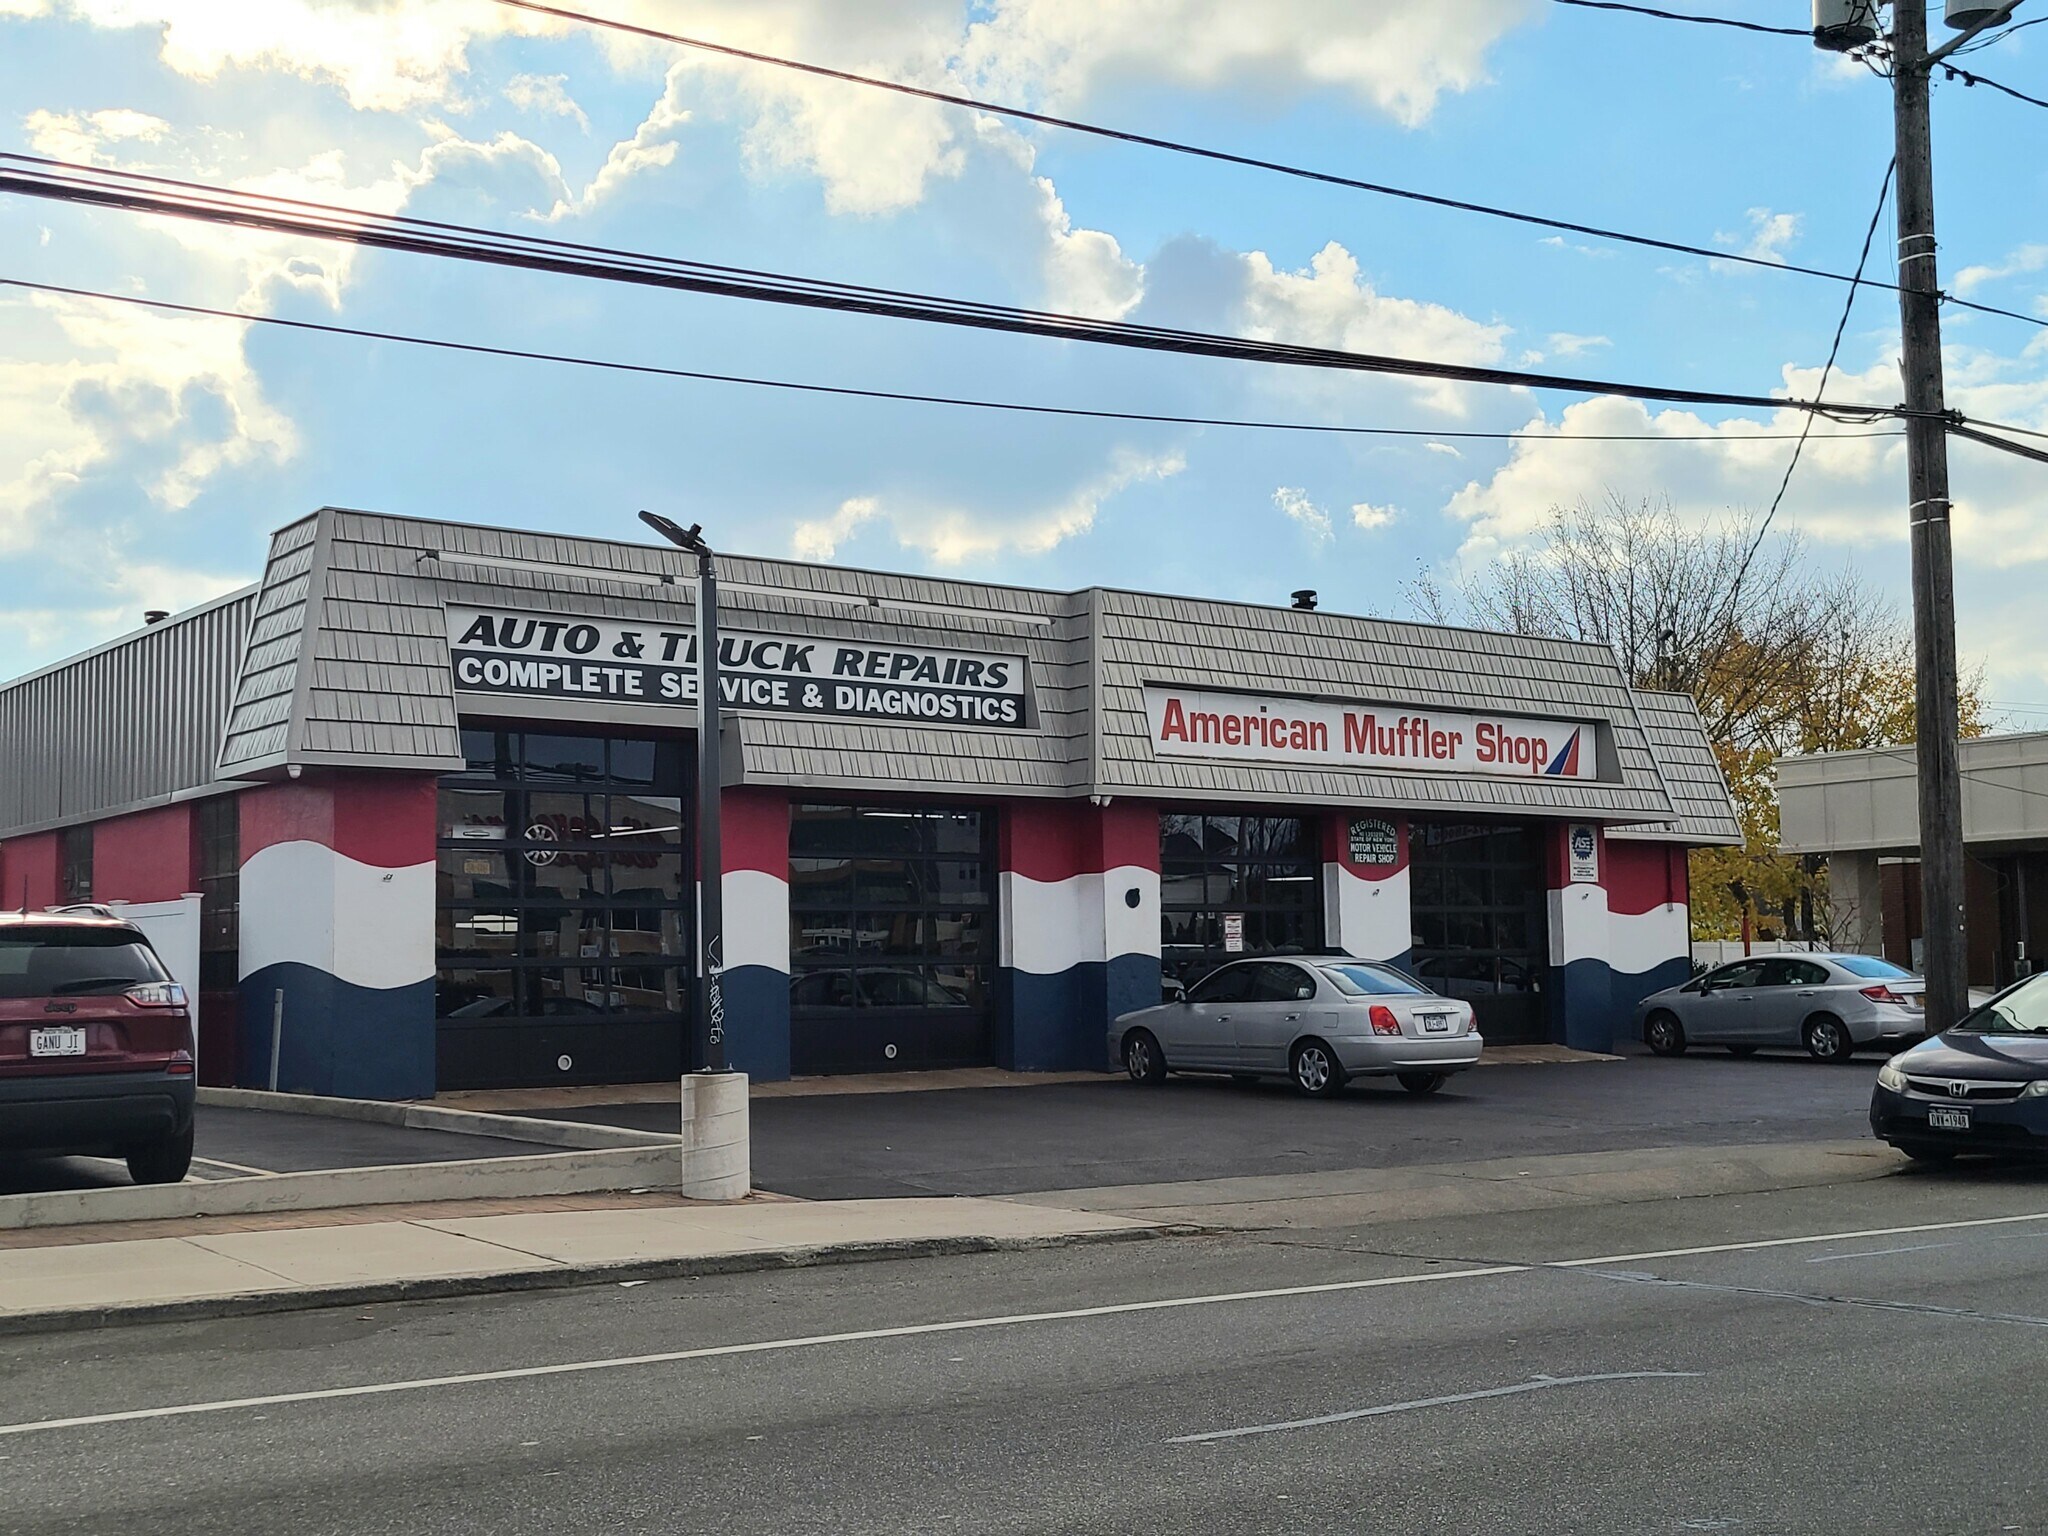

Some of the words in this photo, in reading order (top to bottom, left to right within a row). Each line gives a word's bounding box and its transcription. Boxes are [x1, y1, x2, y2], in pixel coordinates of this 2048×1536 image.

[458, 614, 600, 654] AUTO
[612, 632, 645, 659] &
[832, 648, 1009, 688] REPAIRS
[458, 657, 643, 695] COMPLETE
[660, 672, 789, 706] SEVICE
[801, 683, 823, 708] &
[836, 686, 1017, 722] DIAGNOSTICS
[1160, 698, 1328, 751] American
[1343, 712, 1463, 760] Muffler
[1475, 722, 1548, 774] Shop
[1350, 819, 1396, 836] REGISTERED
[1350, 843, 1371, 852] MOTOR
[1372, 843, 1397, 853] VEHICLE
[1575, 837, 1590, 848] ASE
[1354, 853, 1377, 863] REPAIR
[1378, 854, 1394, 863] SHOP
[36, 1035, 61, 1050] GANU
[67, 1035, 78, 1048] JI
